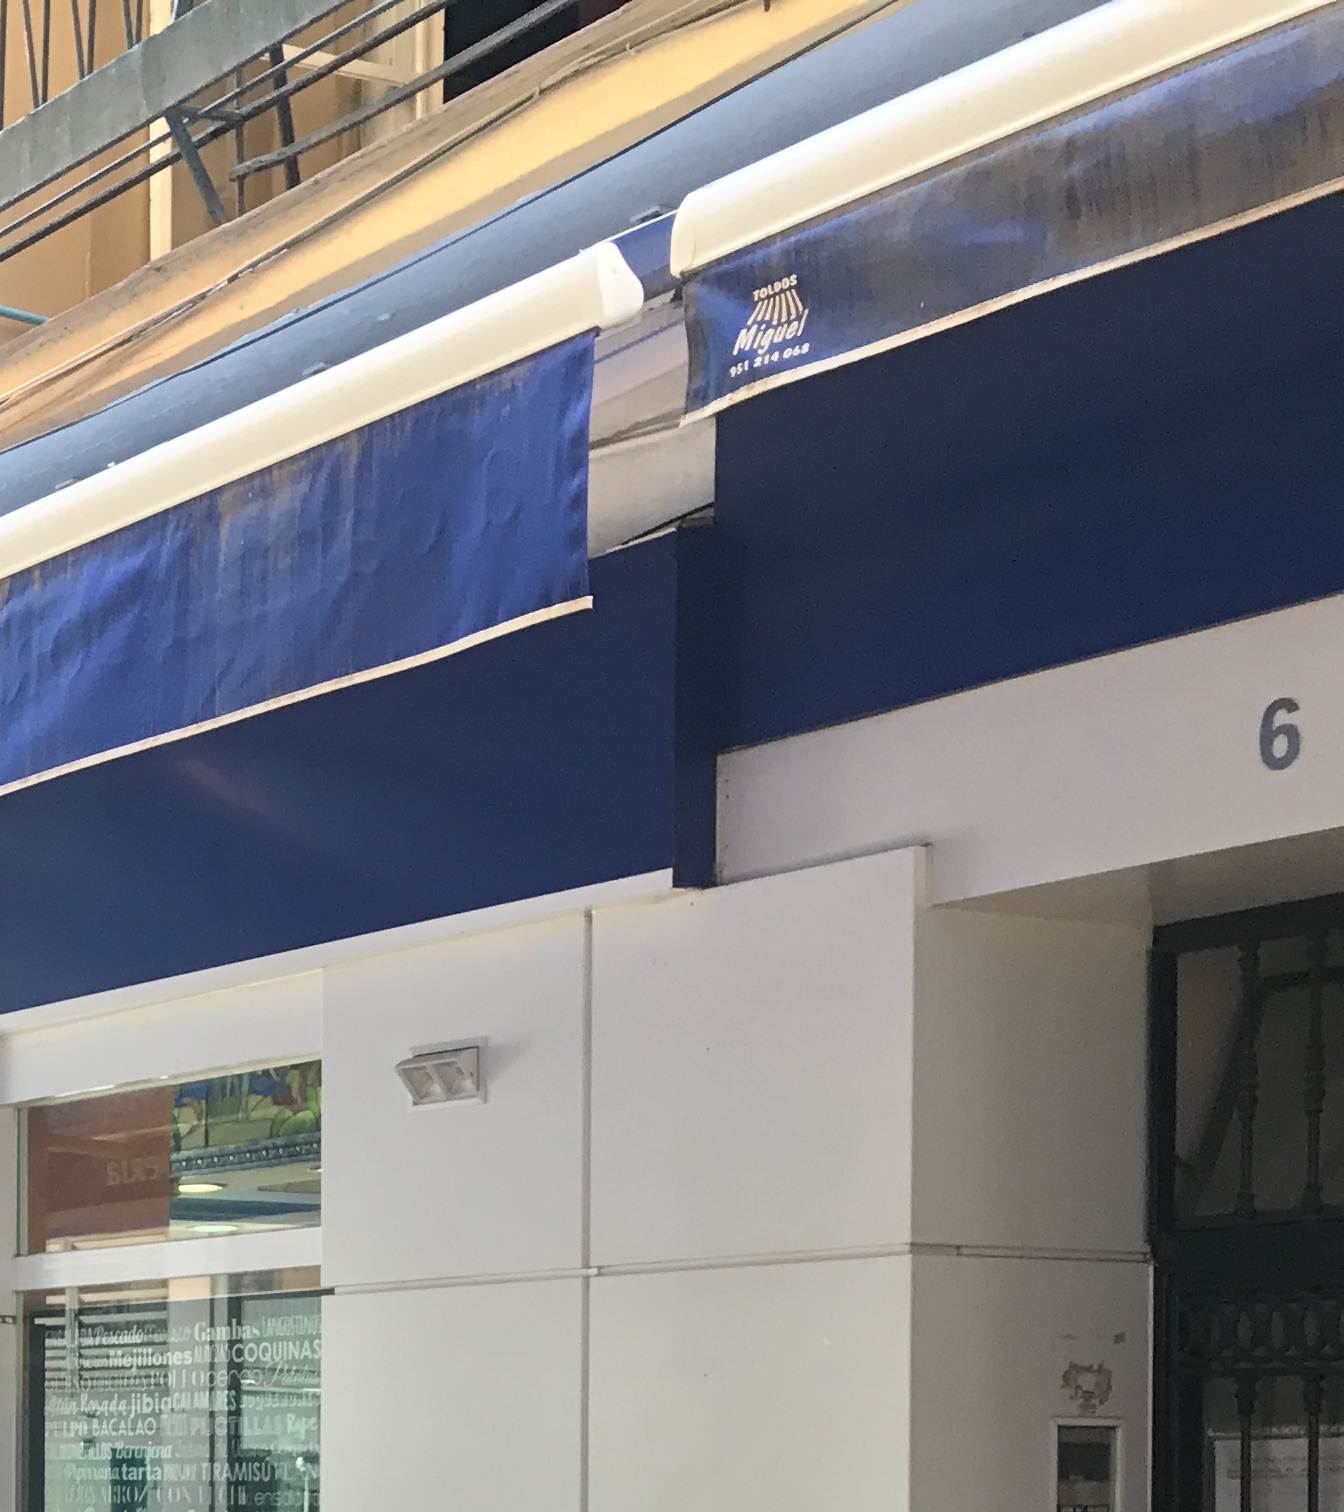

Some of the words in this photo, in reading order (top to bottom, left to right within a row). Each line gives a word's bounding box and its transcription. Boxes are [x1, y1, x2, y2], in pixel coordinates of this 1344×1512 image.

[752, 273, 798, 302] TOLDOS
[732, 308, 810, 356] Miguel
[729, 359, 750, 378] 951
[753, 351, 780, 368] 214
[1258, 696, 1302, 771] 6
[194, 1318, 260, 1342] Gambas
[109, 1348, 193, 1372] Mejillones
[232, 1338, 321, 1363] COQUINAS
[131, 1392, 172, 1419] jibia
[92, 1416, 157, 1436] BACALAO
[120, 1461, 162, 1481] tarta
[201, 1456, 273, 1482] TIRAMISÚ
